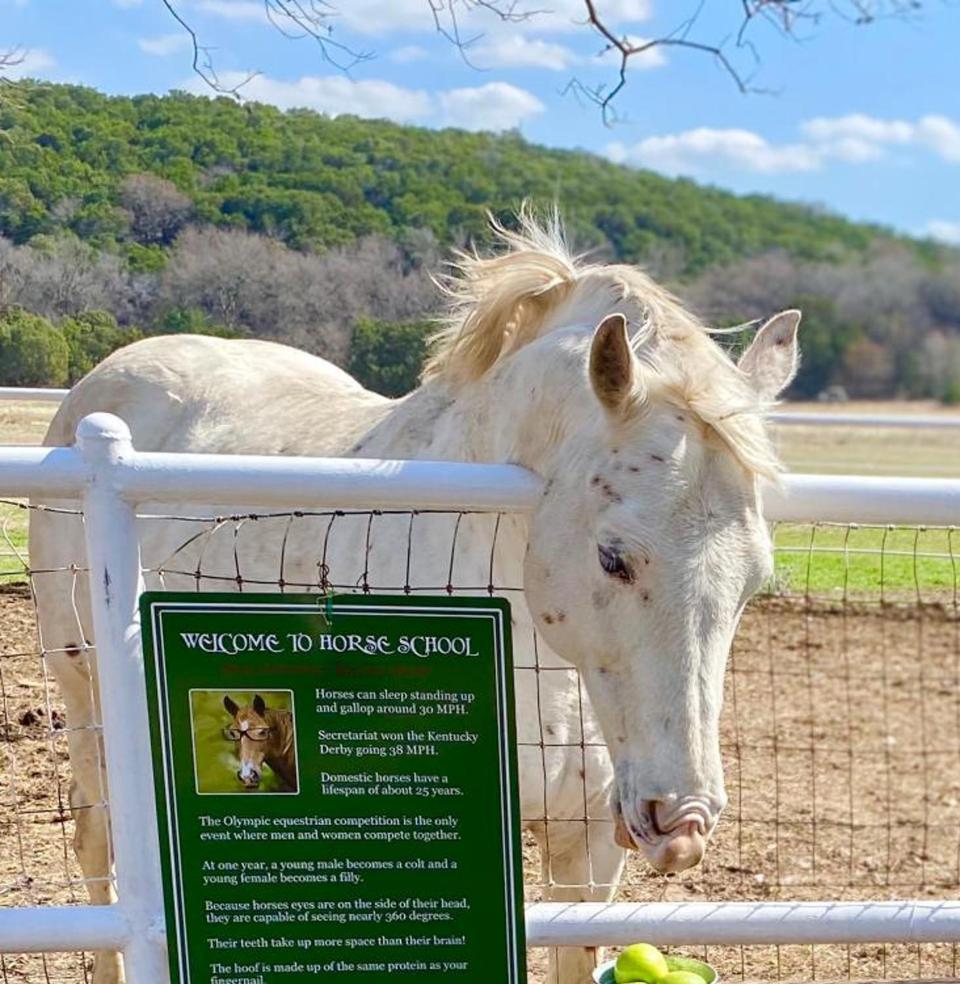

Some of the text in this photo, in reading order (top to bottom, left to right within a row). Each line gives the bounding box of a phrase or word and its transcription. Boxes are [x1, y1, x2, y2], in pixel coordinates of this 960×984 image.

[180, 632, 480, 657] WELCOME TO HORSE SCHOOL
[315, 688, 475, 703] Horses can sleep standing up
[316, 702, 468, 716] and gallop around 30 MPH.
[318, 730, 479, 744] Secretariat won the Kentucky
[320, 745, 439, 758] Derby going 38 MPH.
[320, 772, 448, 783] Domestic horses have a
[321, 784, 463, 797] lifespan of about 25 years.
[198, 815, 458, 828] The Olympic equestrian competition is the only
[200, 829, 462, 842] event where men and women compete together.
[202, 860, 216, 870] At
[218, 861, 238, 870] one
[270, 862, 278, 870] a
[280, 861, 315, 873] young
[316, 859, 344, 870] male
[346, 859, 394, 870] becomes
[396, 861, 403, 869] a
[405, 859, 425, 869] colt
[427, 859, 448, 869] and
[450, 861, 458, 869] a
[203, 874, 238, 885] young
[240, 872, 278, 883] female
[280, 871, 328, 883] becomes
[339, 871, 364, 885] filly.
[205, 898, 470, 912] Because horses eyes are on the side of their head,
[205, 910, 453, 925] they are capable of seeing nearly 360 degrees.
[207, 935, 466, 950] Their teeth take up more space than their brain!
[209, 960, 468, 974] The hoof is made up of the same protein as your
